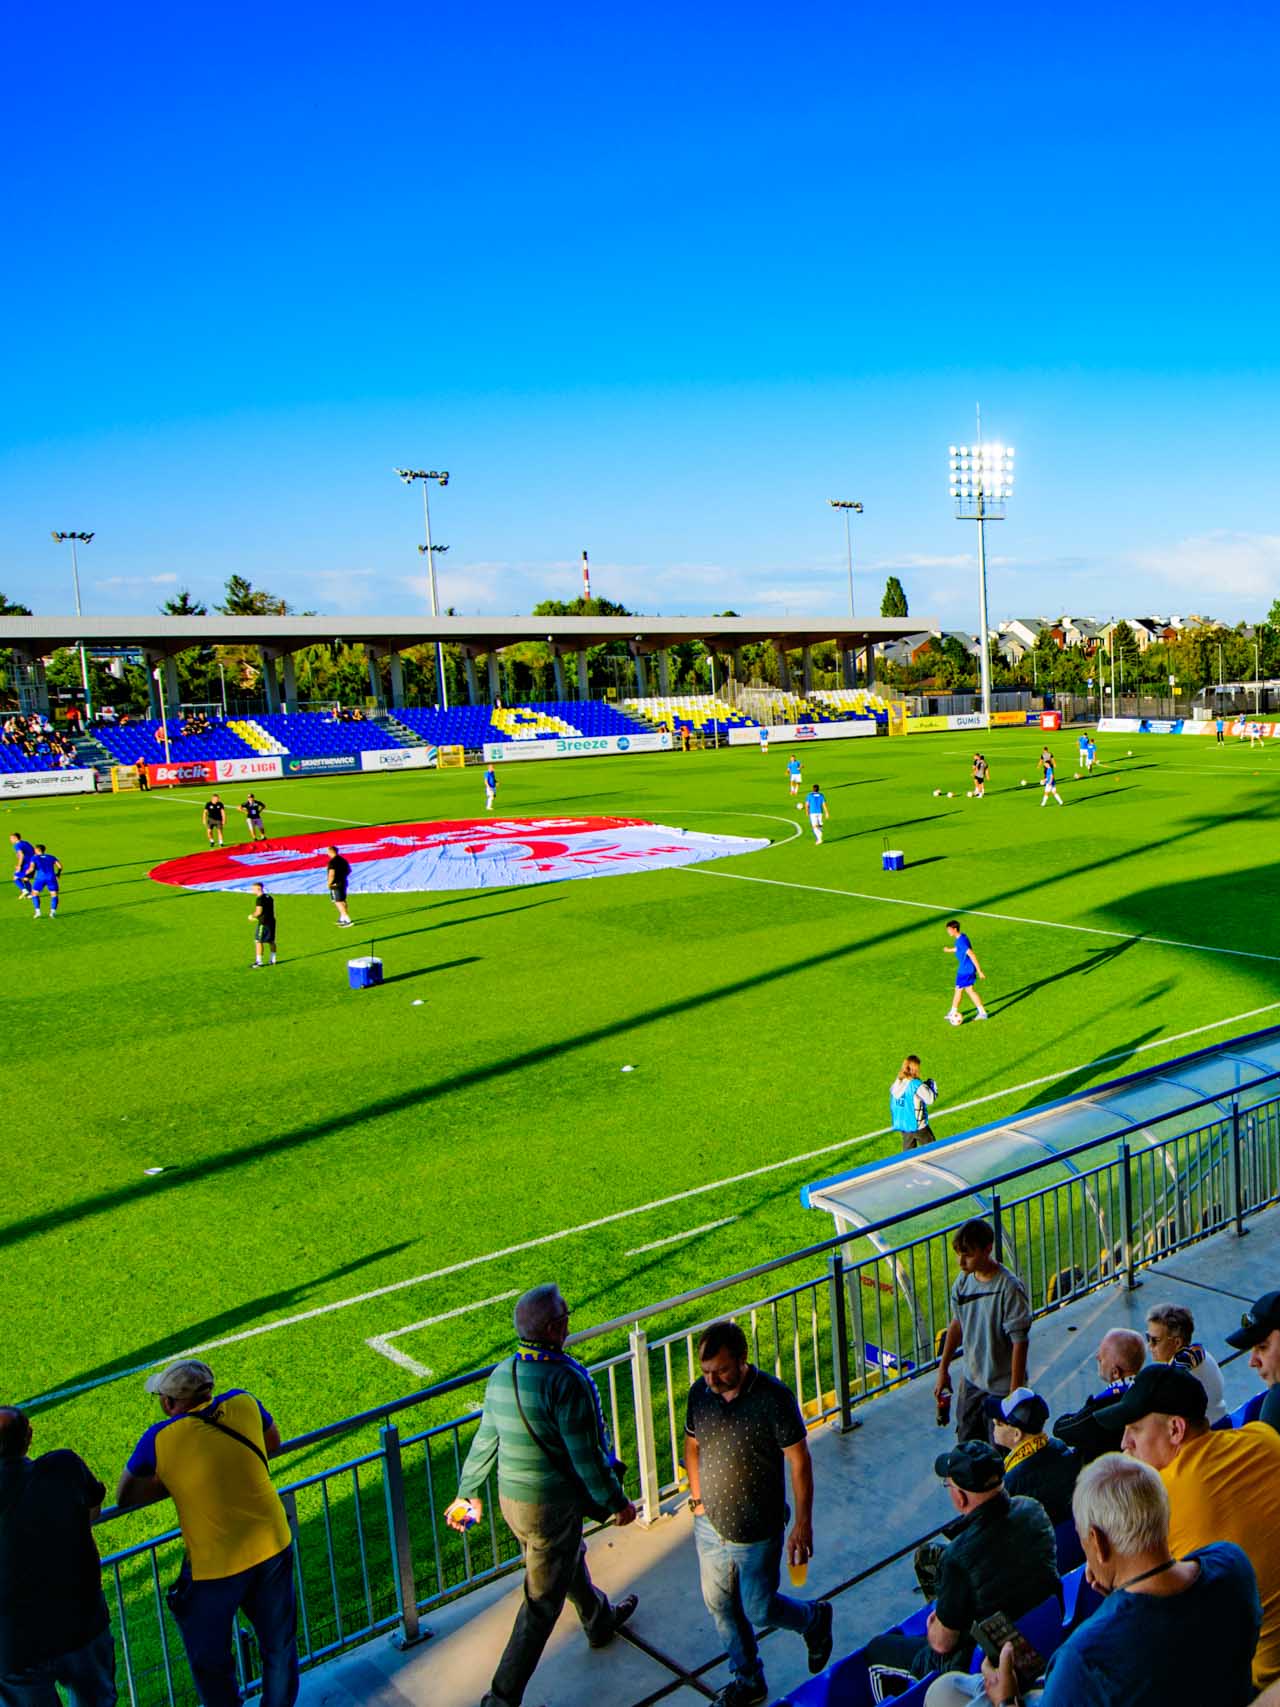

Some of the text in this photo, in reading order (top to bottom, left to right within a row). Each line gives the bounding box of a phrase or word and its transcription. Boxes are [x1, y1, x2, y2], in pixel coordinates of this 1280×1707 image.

[556, 738, 609, 752] Breeze
[156, 764, 211, 780] Betclic
[251, 762, 276, 773] LIGA
